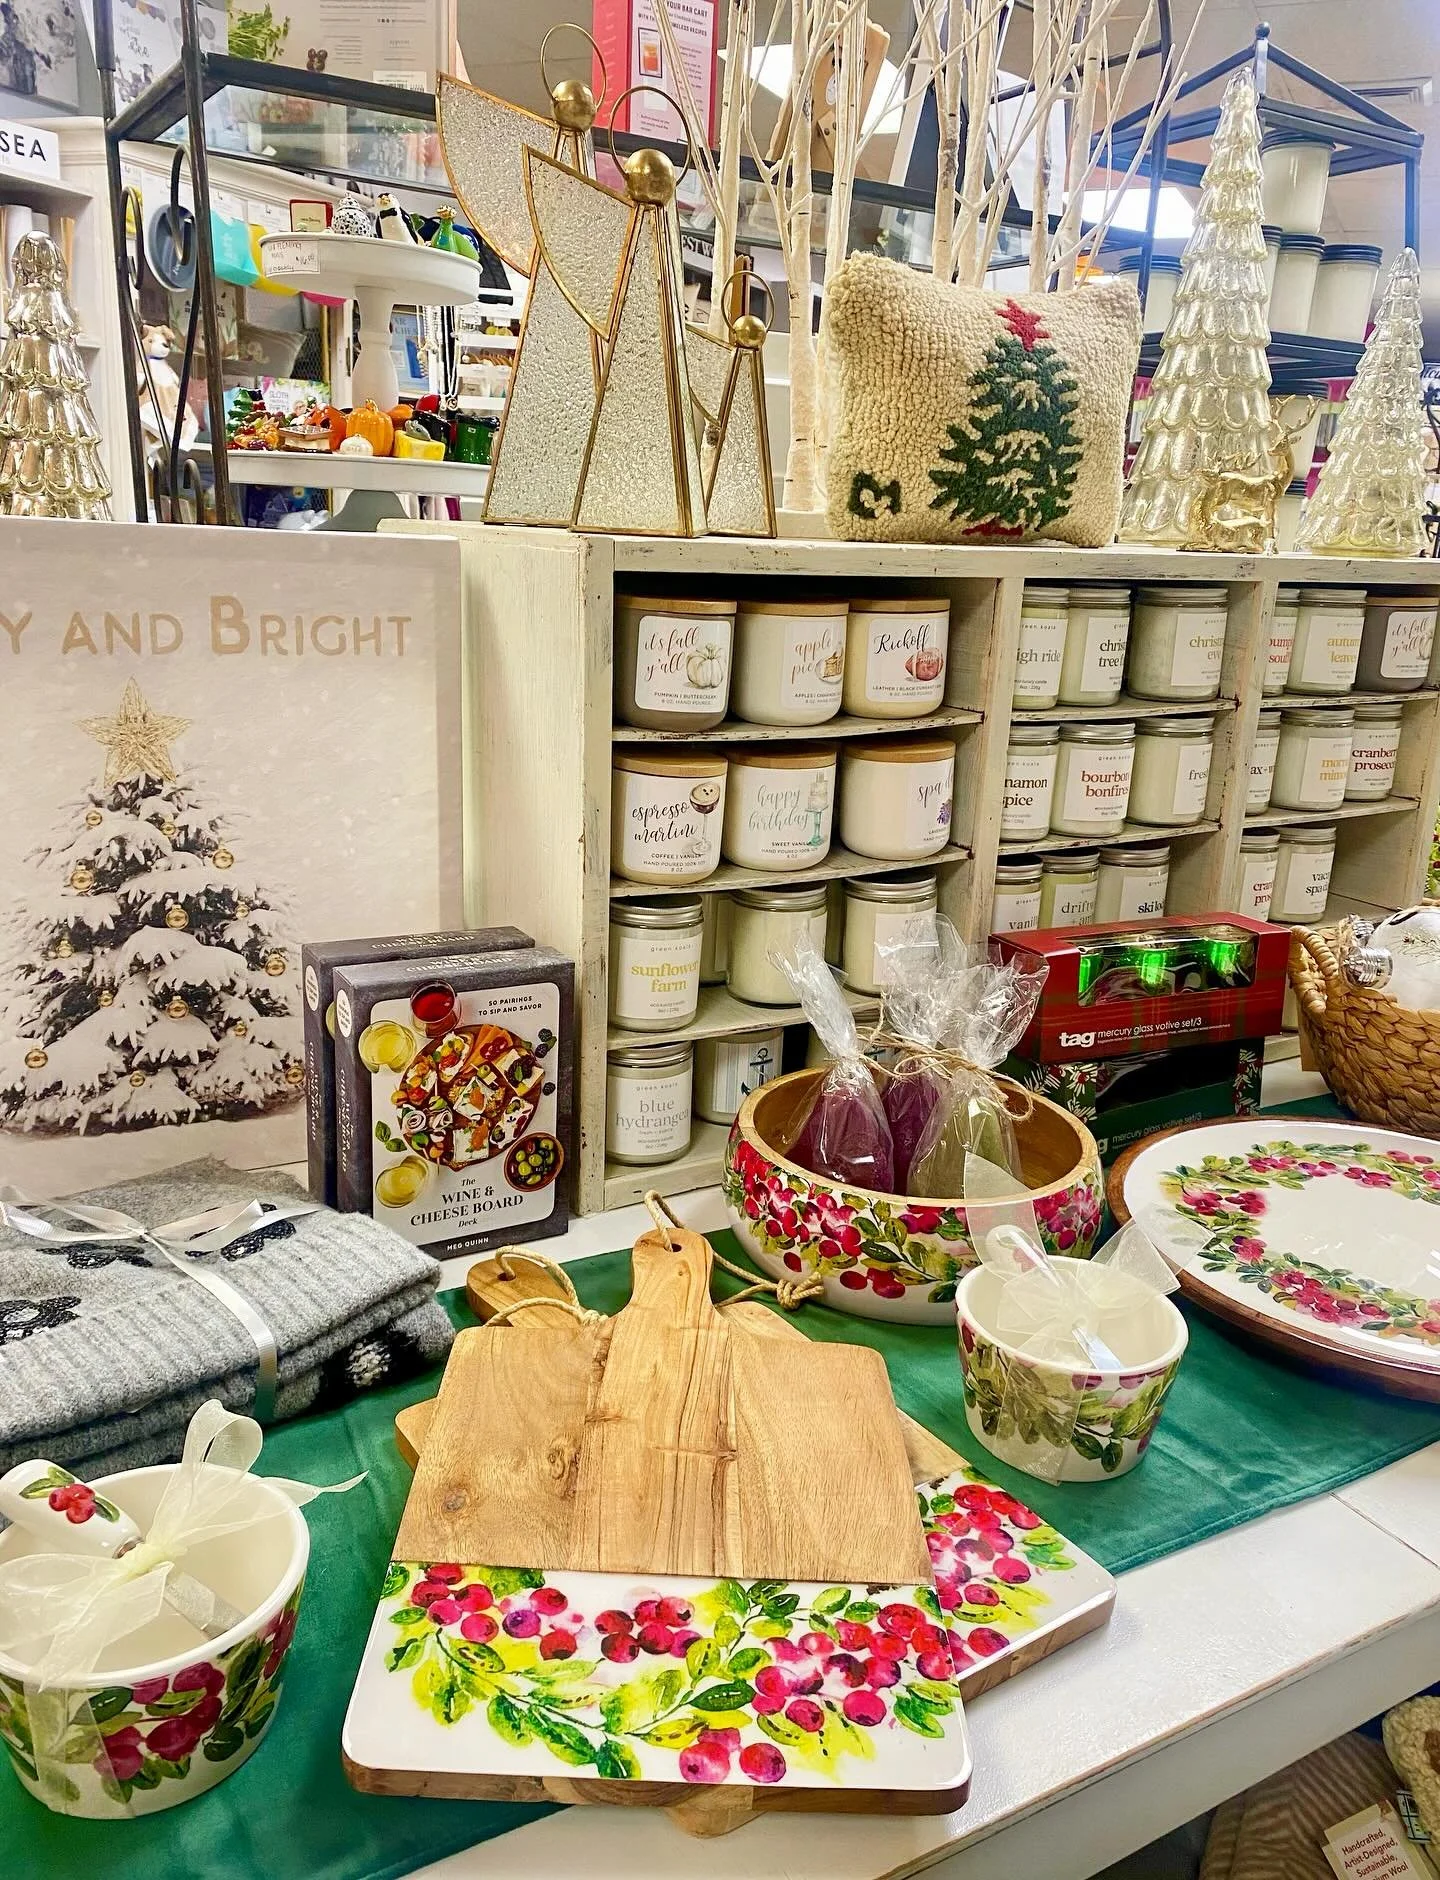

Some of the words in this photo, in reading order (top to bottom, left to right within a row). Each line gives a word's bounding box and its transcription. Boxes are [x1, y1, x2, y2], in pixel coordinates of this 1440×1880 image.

[0, 130, 46, 161] SEA
[61, 611, 184, 656] AND
[209, 595, 412, 657] BRIGHT
[1408, 616, 1430, 639] fall
[667, 626, 699, 656] fall
[795, 628, 833, 663] apple
[647, 652, 685, 682] y'all
[1041, 650, 1061, 662] ride
[1099, 656, 1120, 668] tree
[791, 663, 814, 685] pie
[654, 691, 679, 699] PUMPKIN
[1081, 770, 1130, 783] bourbon
[757, 784, 801, 810] happy
[917, 783, 941, 809] spa
[632, 801, 690, 828] espresso
[748, 806, 809, 832] birthday
[634, 820, 699, 843] martini
[1137, 902, 1154, 914] ski
[631, 960, 699, 977] sunflower
[650, 979, 687, 993] farm
[499, 995, 533, 1005] PAIRINGS
[519, 1003, 542, 1011] SAVOR
[1059, 1031, 1096, 1048] tag
[1097, 1027, 1132, 1038] mercury
[1133, 1024, 1154, 1036] glass
[1155, 1020, 1181, 1031] votive
[1181, 1016, 1202, 1028] set/3
[639, 1099, 675, 1113] blue
[615, 1108, 689, 1130] hydrangea
[1112, 1130, 1141, 1144] mercury
[1143, 1123, 1161, 1136] glass
[1162, 1118, 1183, 1129] votive
[461, 1177, 476, 1187] The
[441, 1187, 481, 1205] WINE
[484, 1185, 495, 1196] &
[410, 1204, 469, 1226] CHEESE
[472, 1194, 524, 1215] BOARD
[458, 1217, 478, 1228] Deck
[446, 1243, 463, 1252] MEG
[464, 1237, 490, 1248] QUINN
[1343, 1837, 1398, 1870] Artist-Designed,
[1356, 1853, 1398, 1878] Sustainable,
[1388, 1861, 1409, 1877] Wool
